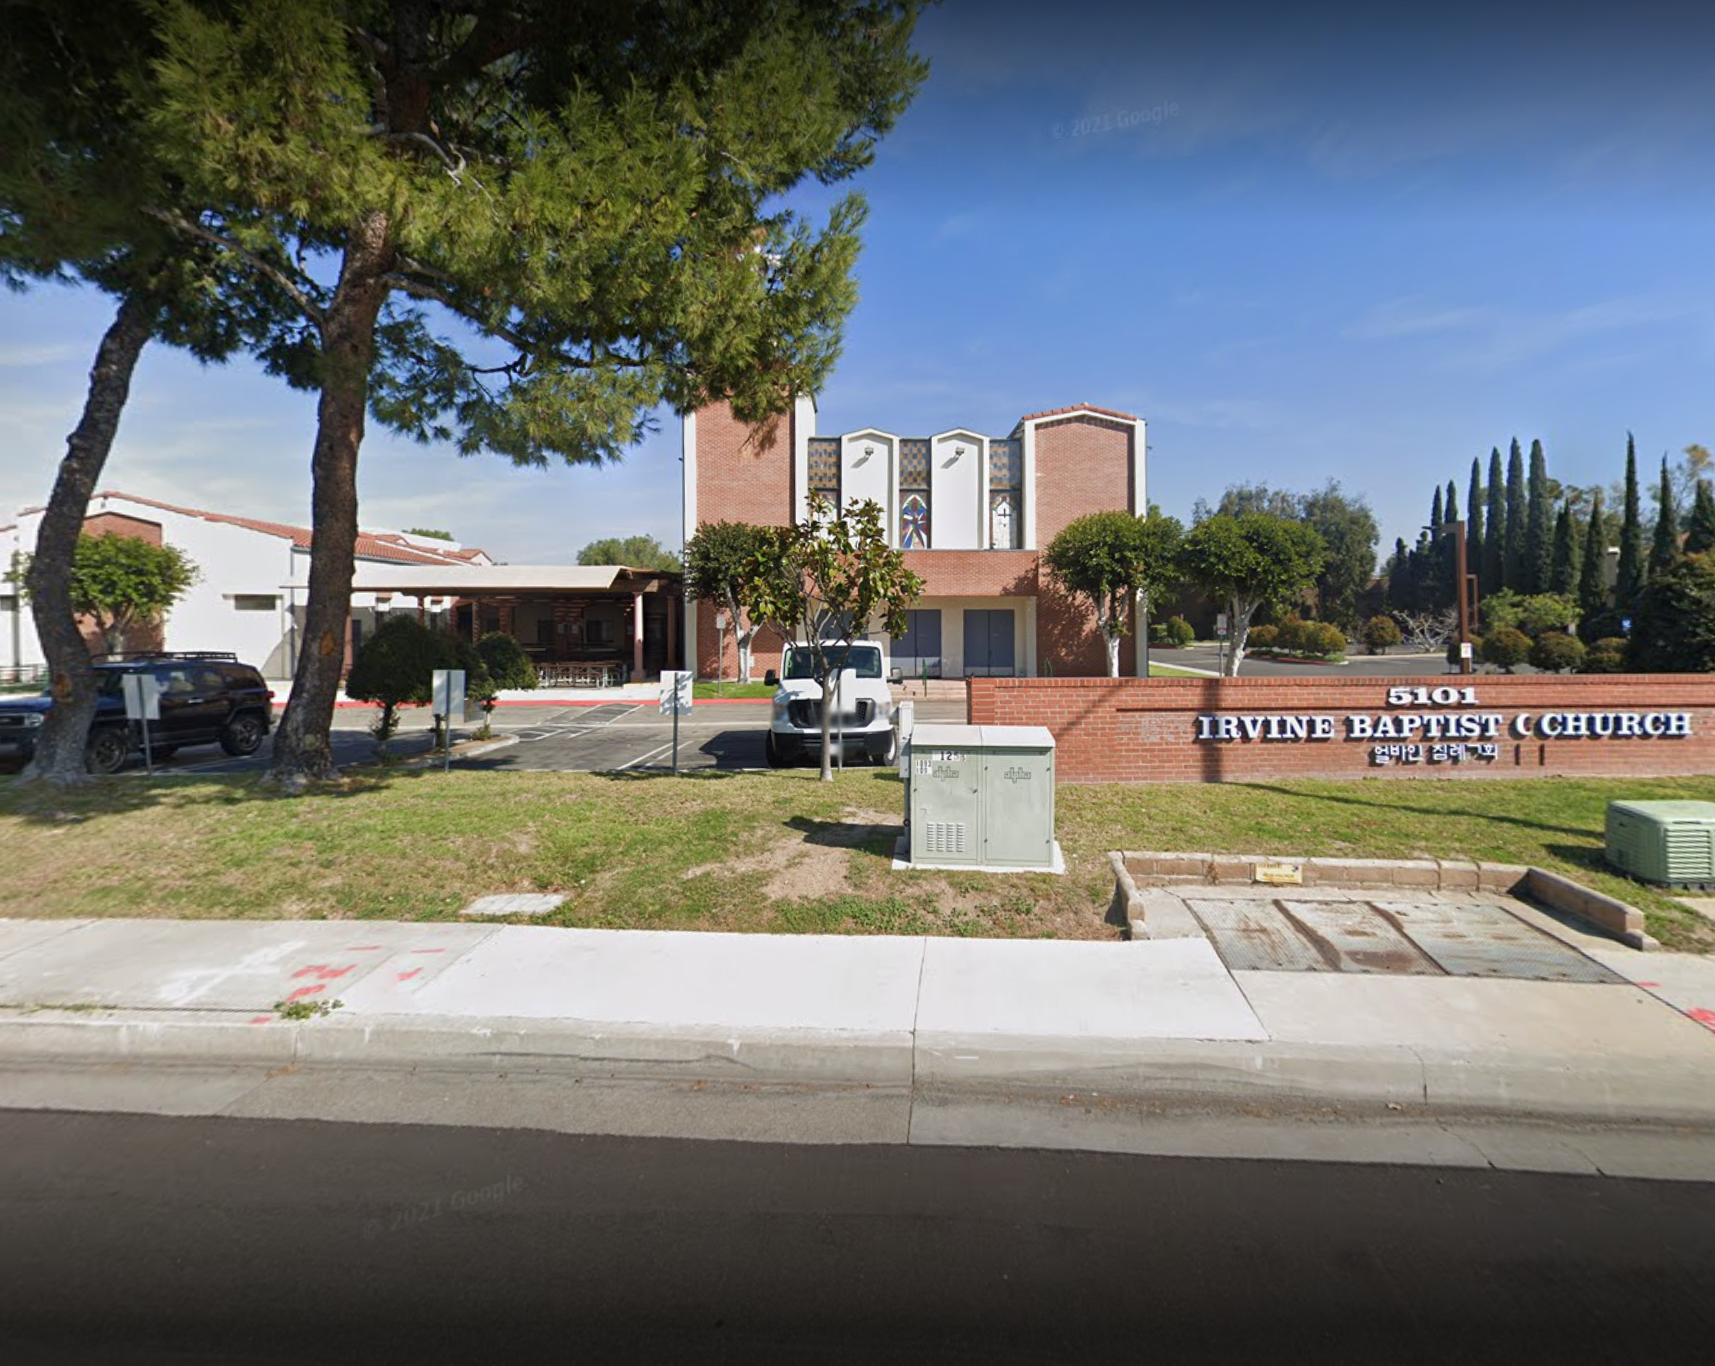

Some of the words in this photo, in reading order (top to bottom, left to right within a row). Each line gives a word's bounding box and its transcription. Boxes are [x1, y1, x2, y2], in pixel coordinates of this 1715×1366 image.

[1388, 686, 1480, 706] 5101
[1198, 716, 1335, 740] IRVINE
[1346, 714, 1503, 739] BAPTIST
[1541, 712, 1693, 737] CHURCH
